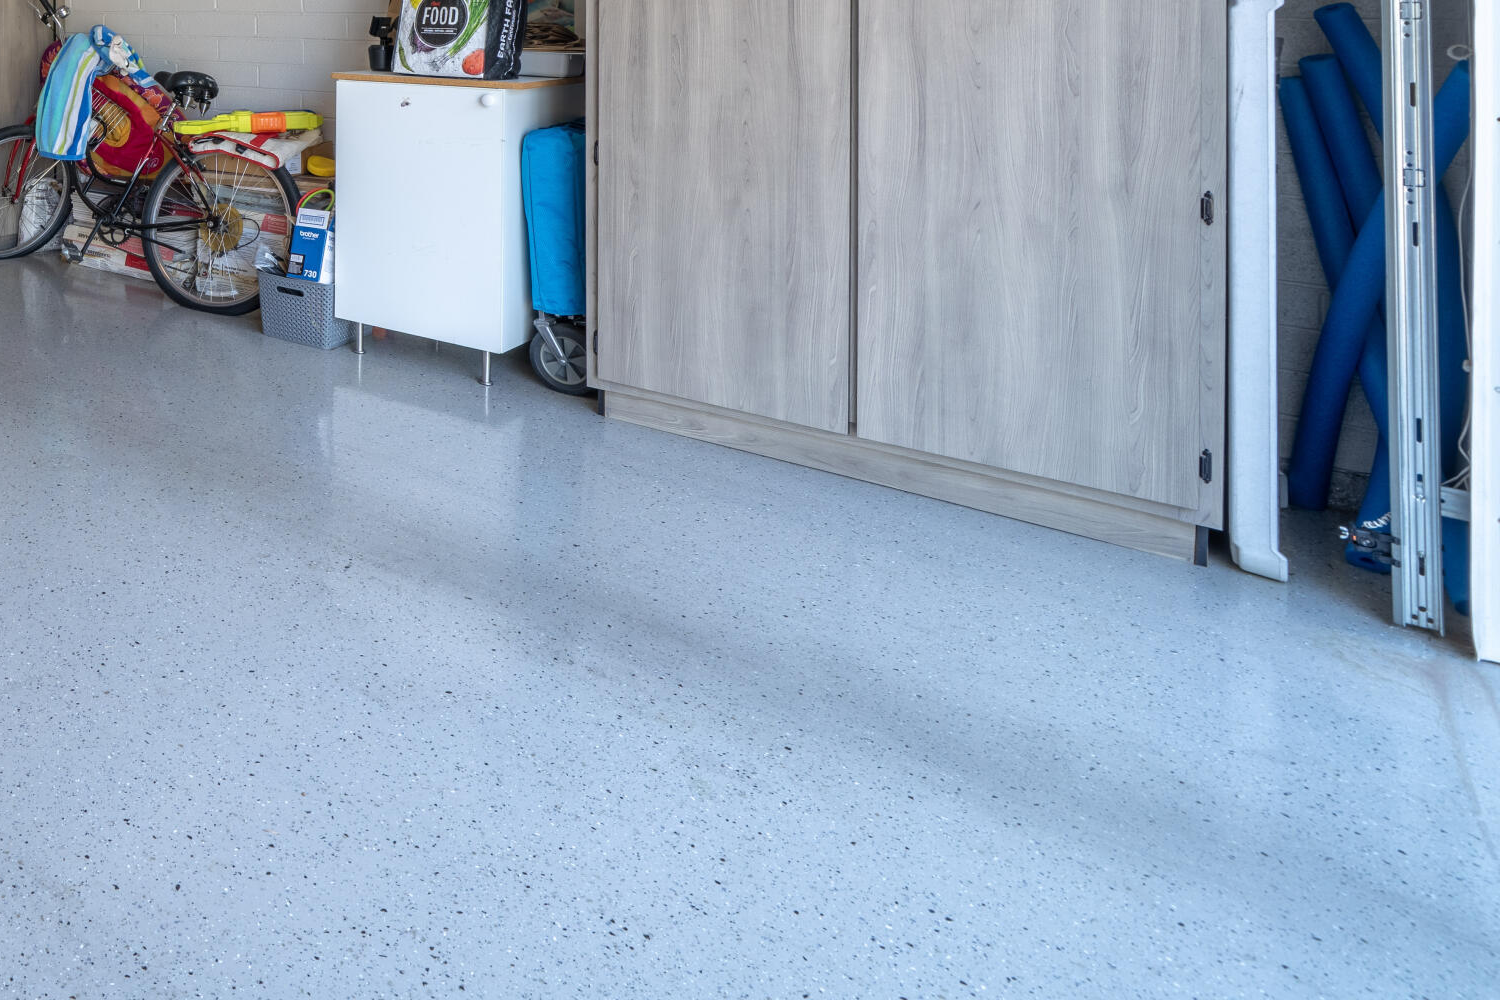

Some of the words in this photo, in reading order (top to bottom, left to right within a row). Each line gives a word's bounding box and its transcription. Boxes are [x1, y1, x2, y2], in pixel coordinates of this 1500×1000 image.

[422, 6, 459, 25] FOOD
[497, 18, 510, 59] EARTH
[300, 231, 320, 239] brother
[303, 269, 317, 279] 730
